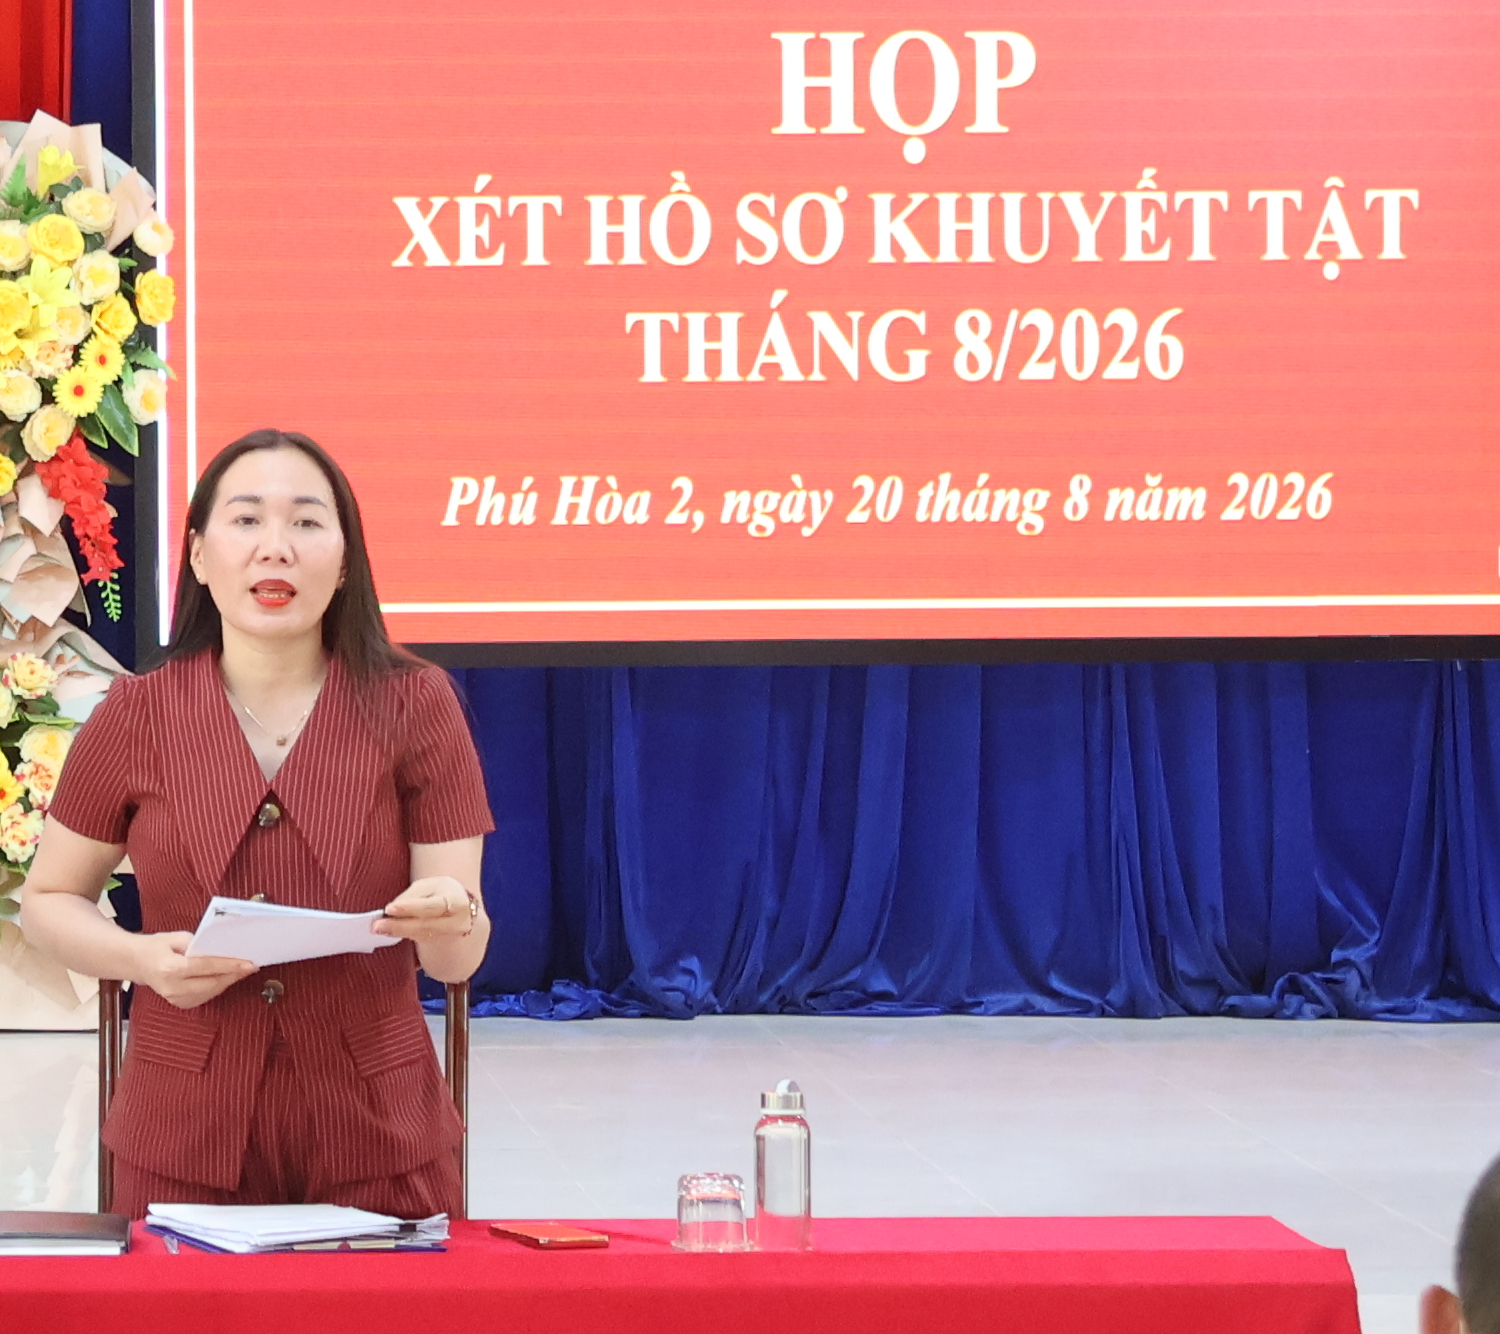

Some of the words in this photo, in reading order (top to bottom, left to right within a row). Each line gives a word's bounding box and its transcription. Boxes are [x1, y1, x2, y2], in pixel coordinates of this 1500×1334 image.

[772, 31, 1036, 164] HỌP
[392, 174, 562, 266] XÉT
[586, 171, 711, 265] HỒ
[737, 187, 847, 264] SƠ
[870, 169, 1228, 263] KHUYẾT
[1249, 177, 1418, 280] TẬT
[626, 290, 930, 382] THÁNG
[954, 308, 1183, 381] 8/2026
[442, 476, 537, 525] Phú
[551, 476, 650, 524] Hòa
[666, 477, 704, 532] 2,
[721, 474, 833, 536] ngày
[846, 475, 903, 522] 20
[916, 473, 1050, 535] tháng
[1064, 475, 1091, 520] 8
[1105, 474, 1206, 520] năm
[1221, 472, 1332, 520] 2026
